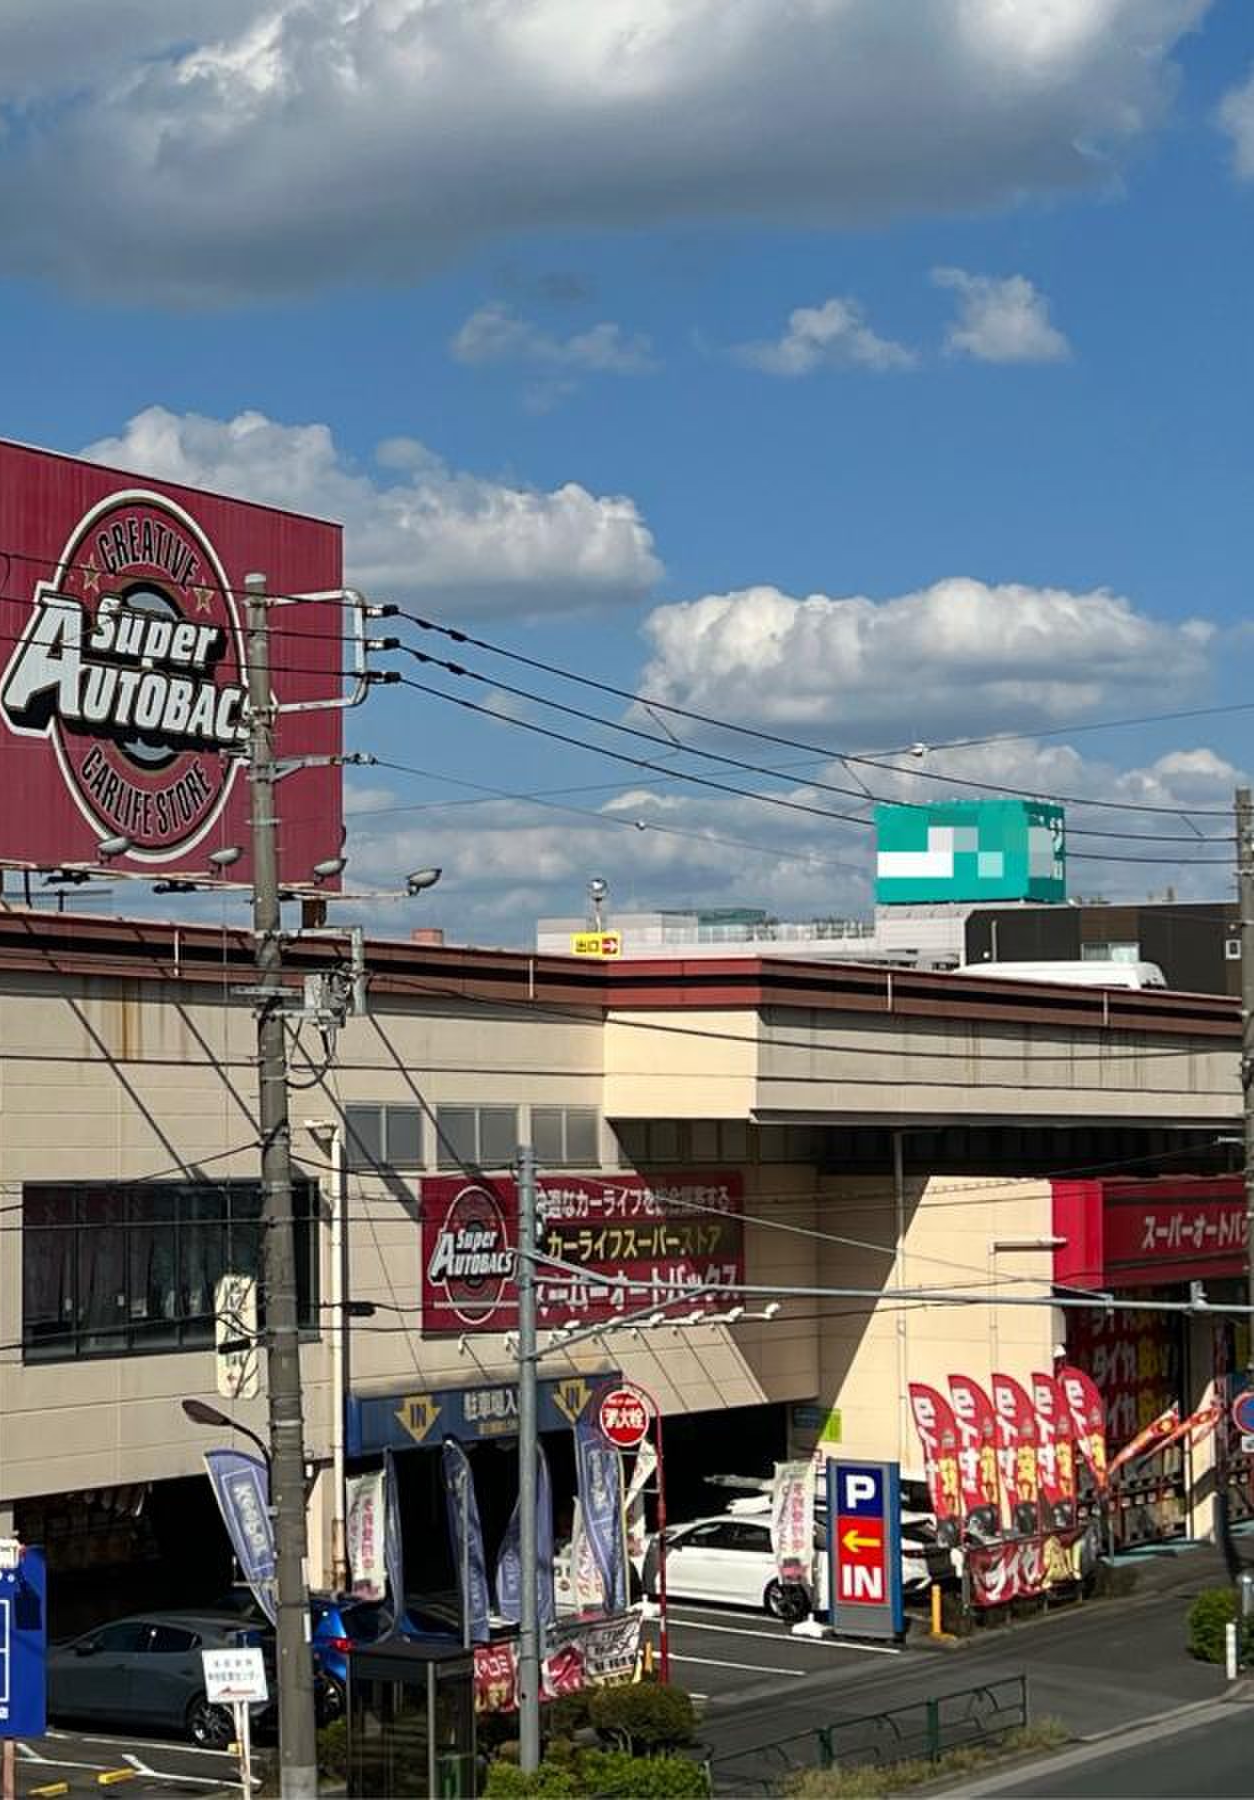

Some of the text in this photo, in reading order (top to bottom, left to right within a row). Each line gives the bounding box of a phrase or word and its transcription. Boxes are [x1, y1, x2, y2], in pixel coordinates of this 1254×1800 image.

[97, 519, 198, 586] CREATIVE
[91, 598, 219, 668] Super
[81, 744, 216, 837] CARLIFE STORE
[457, 1228, 498, 1252] Super
[547, 1224, 722, 1262] カーライフスーパーストア
[1142, 1210, 1247, 1249] スーパーオートバ
[430, 1232, 514, 1277] AUTOBACS
[410, 1404, 427, 1428] IN
[847, 1474, 876, 1509] P
[842, 1564, 883, 1599] IN
